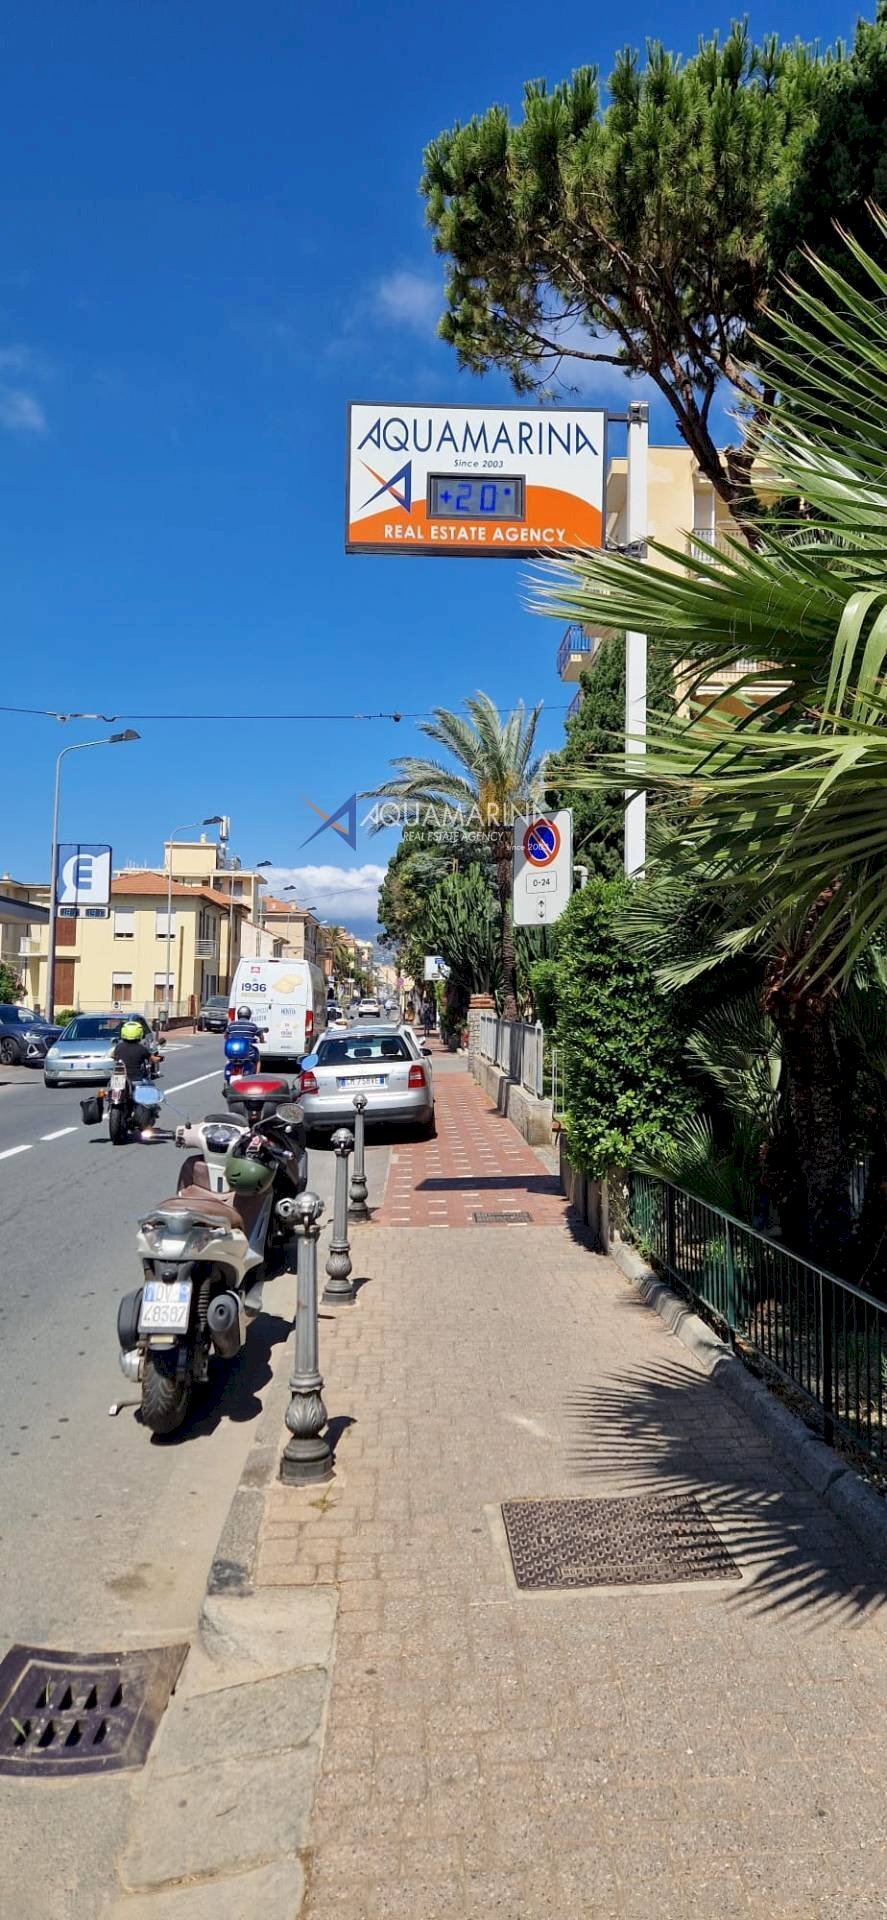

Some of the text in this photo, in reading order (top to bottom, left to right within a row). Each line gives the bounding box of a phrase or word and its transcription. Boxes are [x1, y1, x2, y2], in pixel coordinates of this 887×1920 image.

[357, 416, 599, 456] AQUAMARINA
[454, 459, 504, 469] Since 2003
[384, 524, 566, 543] REAL ESTATE AGENCY
[241, 982, 267, 993] 1936
